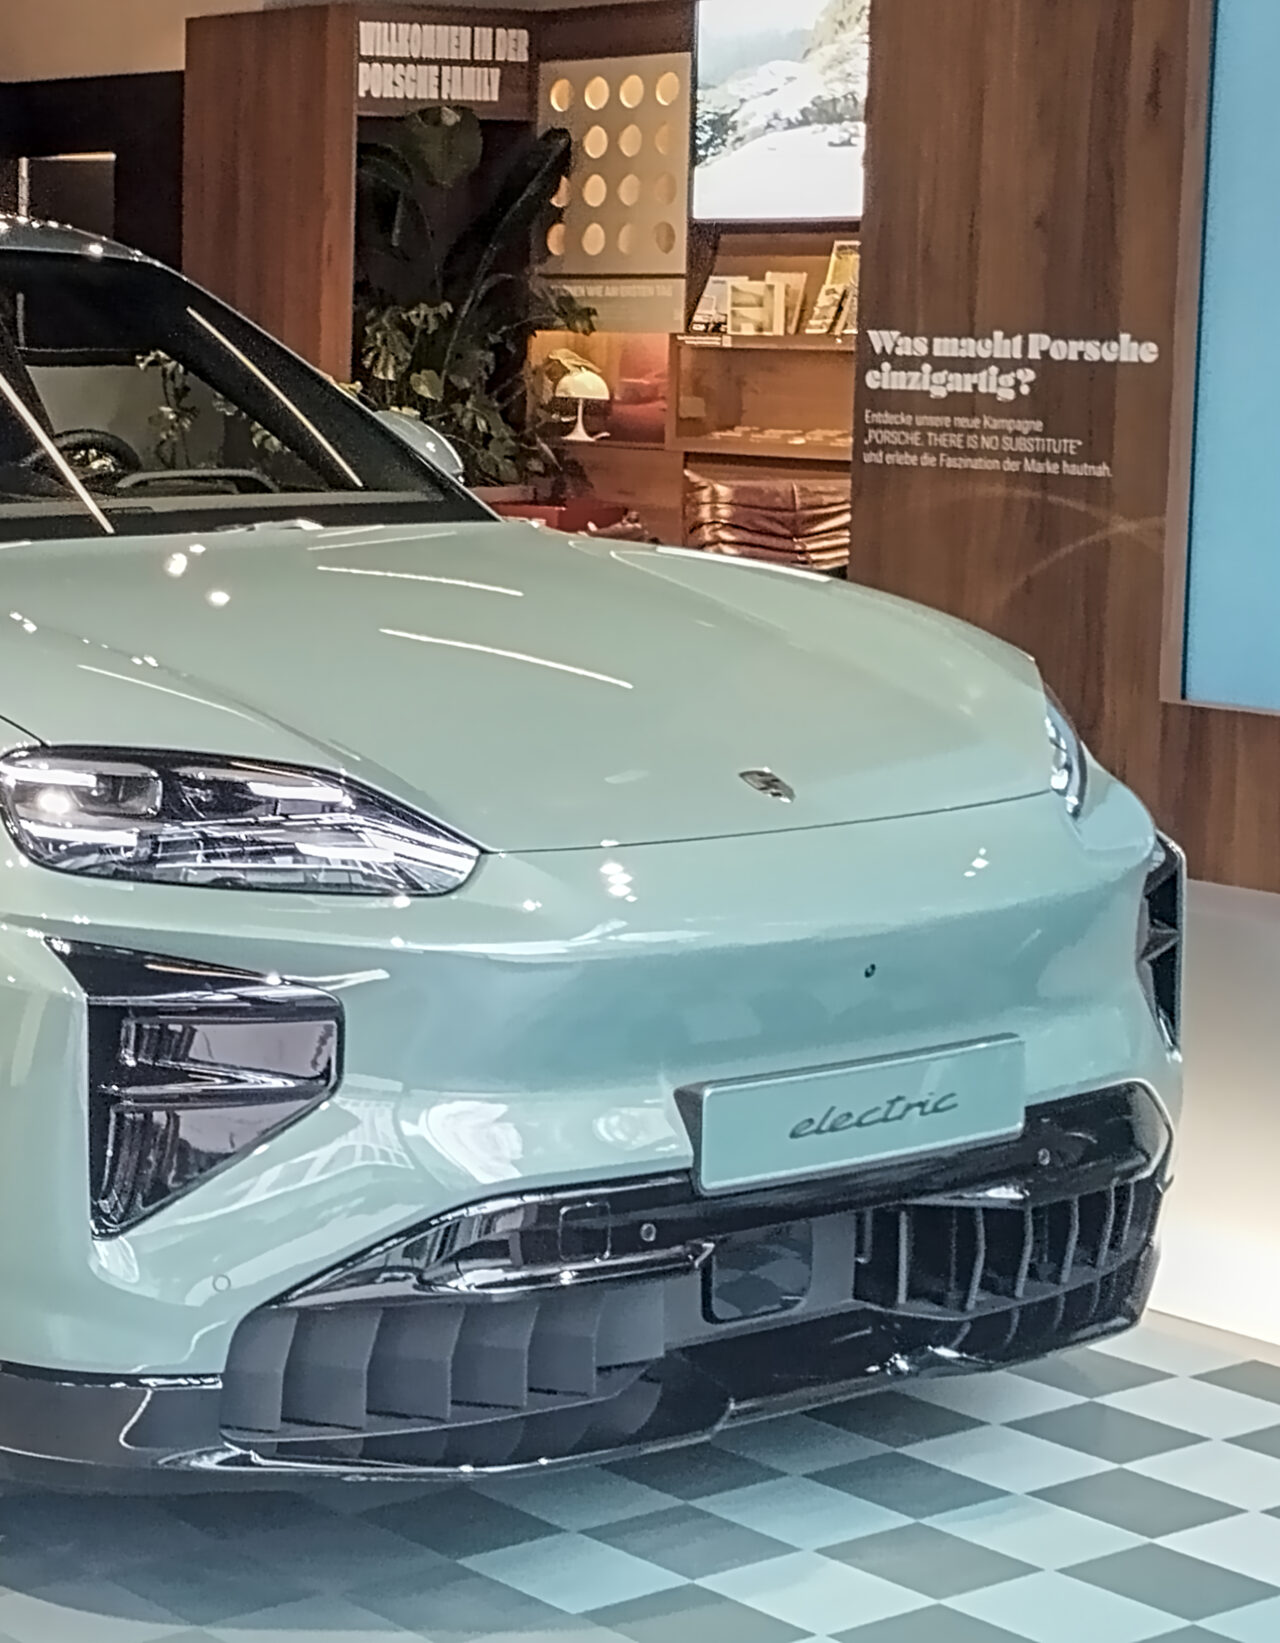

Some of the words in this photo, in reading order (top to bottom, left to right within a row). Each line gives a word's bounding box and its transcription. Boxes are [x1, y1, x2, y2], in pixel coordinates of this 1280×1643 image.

[358, 20, 472, 60] WILLKOMMEN
[473, 26, 493, 60] IN
[495, 27, 529, 62] DER
[358, 62, 439, 100] PORSCHE
[441, 65, 501, 102] FAMILY
[866, 329, 930, 357] Was
[932, 330, 1023, 359] macht
[1027, 332, 1160, 364] Porsche
[864, 361, 1037, 403] einzigartig?
[864, 408, 913, 425] Entdecke
[915, 414, 951, 428] unsere
[953, 416, 981, 429] neue
[983, 413, 1044, 435] Kampagne
[926, 431, 965, 449] THERE
[966, 433, 979, 450] IS
[980, 434, 1000, 450] NO
[862, 449, 884, 464] und
[885, 450, 918, 466] erlebe
[920, 451, 937, 467] die
[939, 452, 1001, 470] Faszination
[1002, 455, 1022, 472] der
[1023, 456, 1060, 475] Marke
[1061, 459, 1113, 478] hautnah.
[788, 1090, 959, 1140] electric
